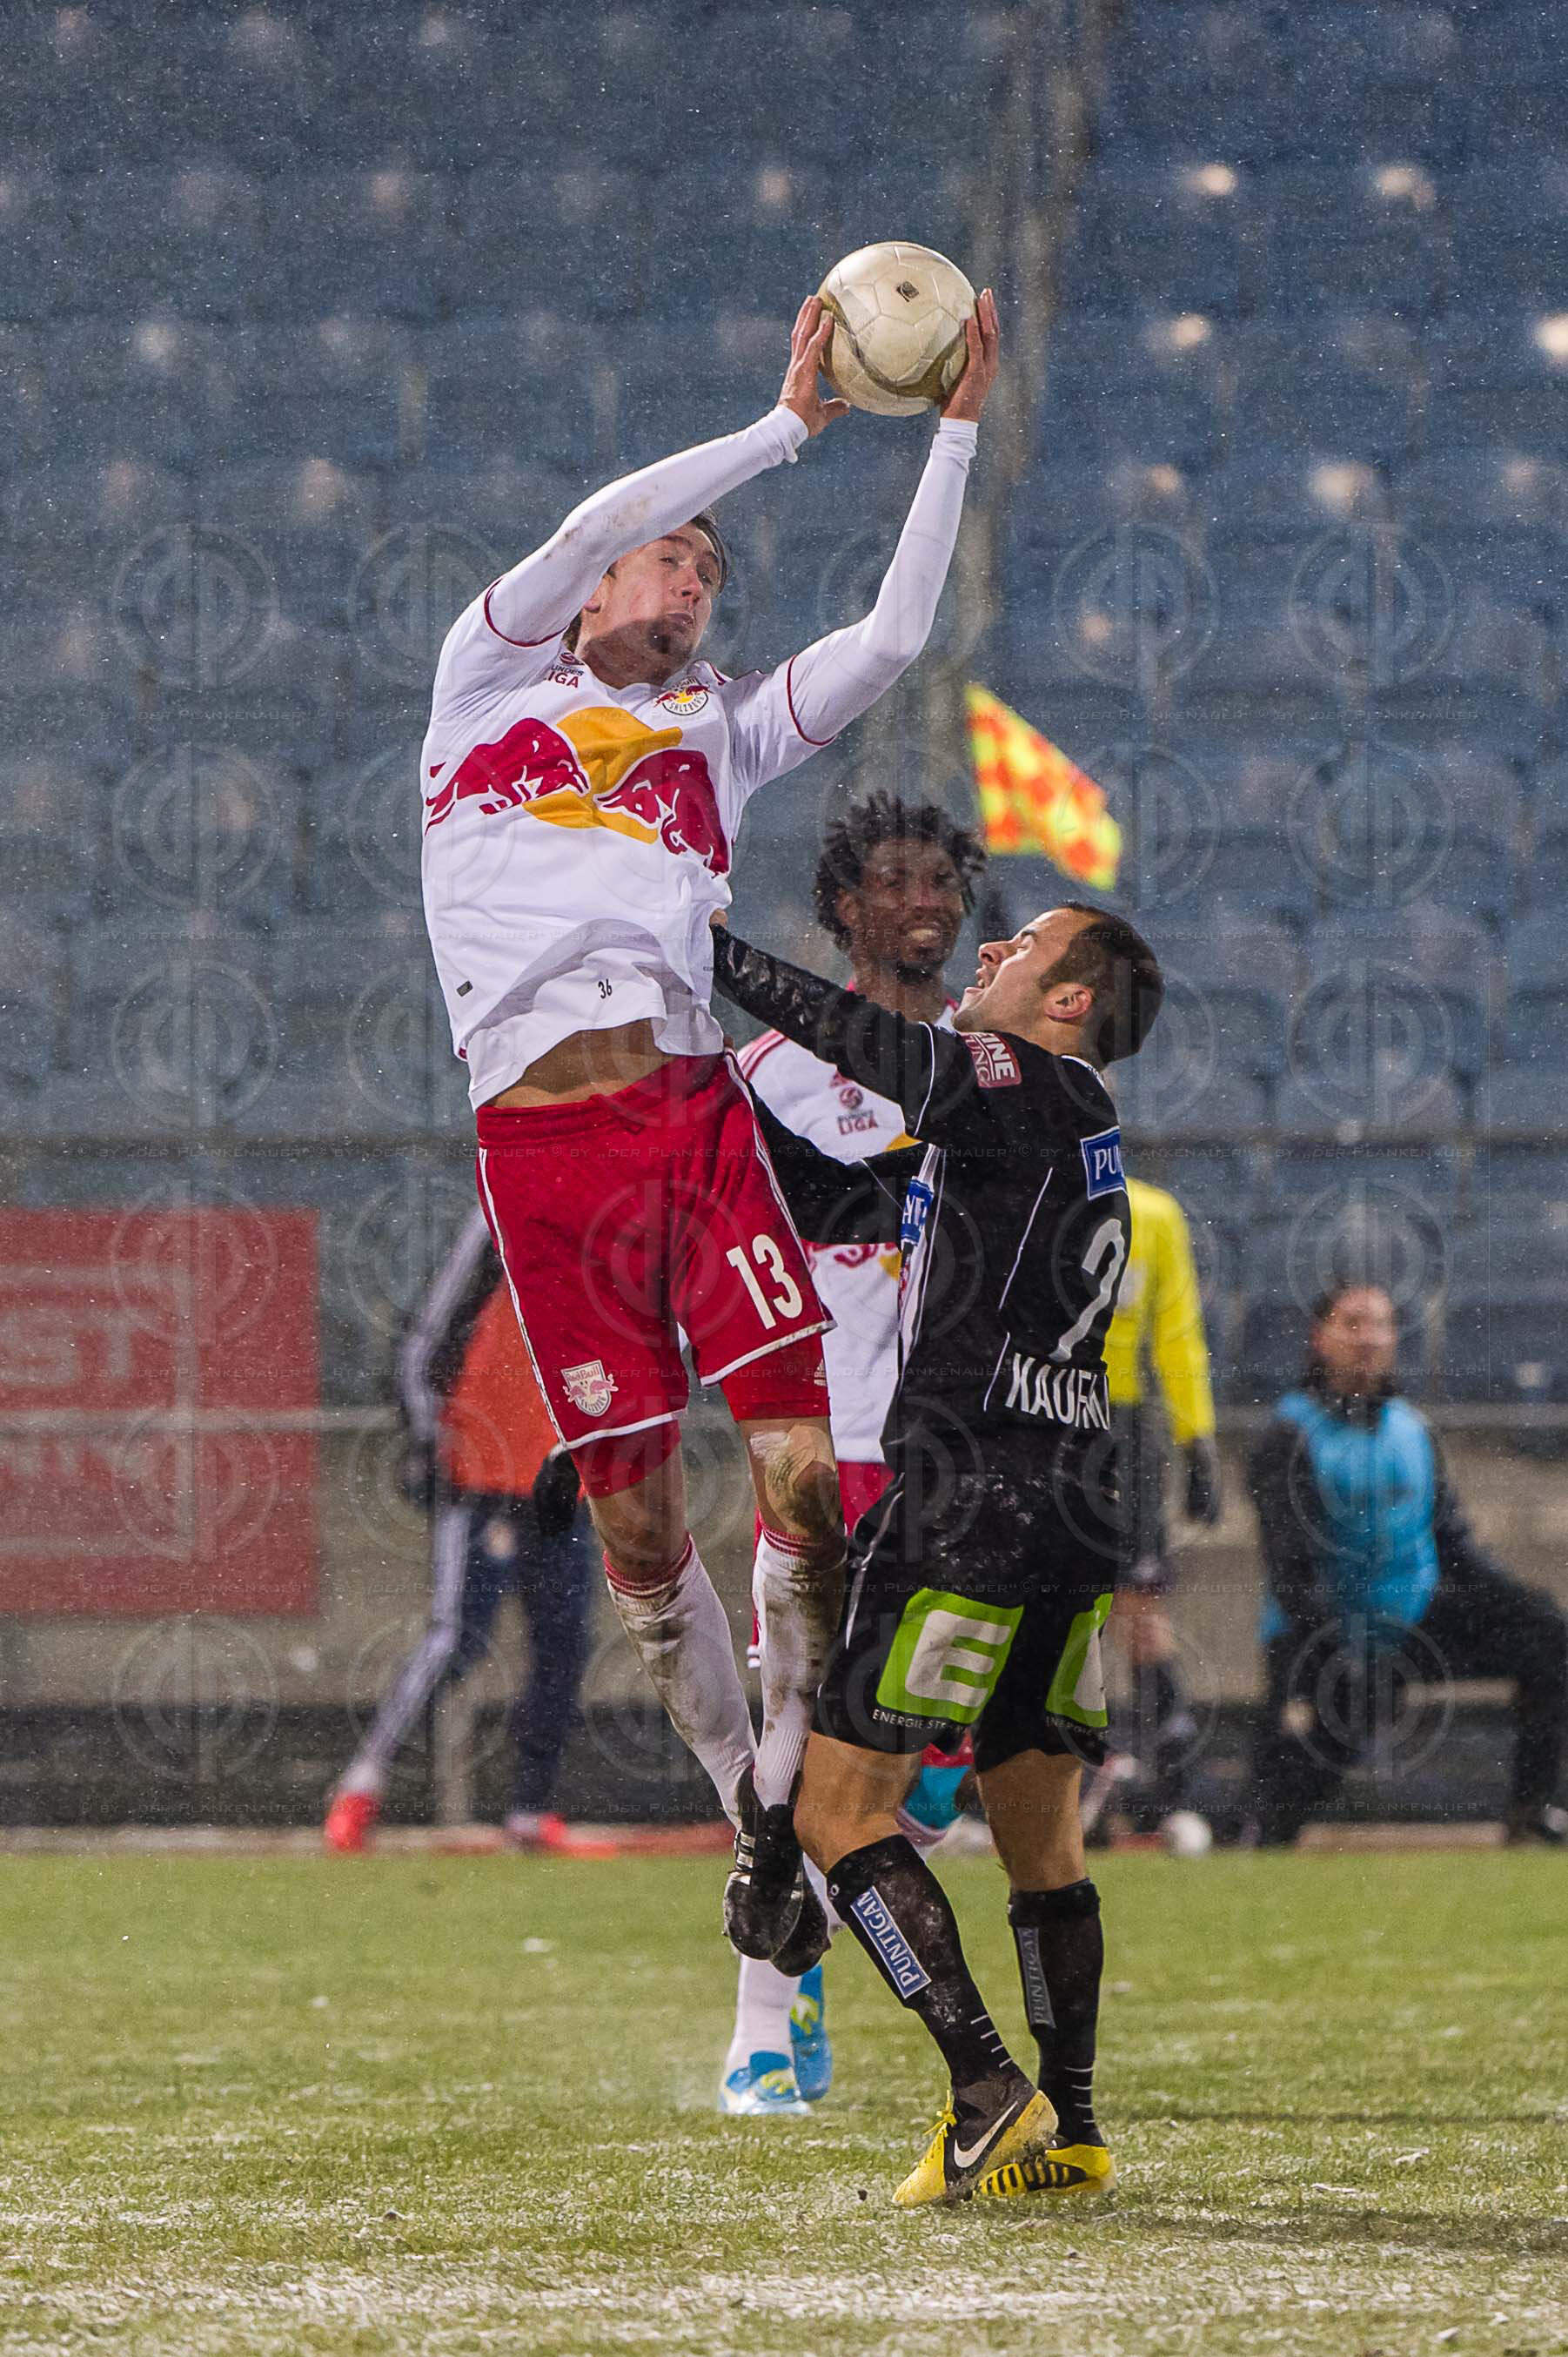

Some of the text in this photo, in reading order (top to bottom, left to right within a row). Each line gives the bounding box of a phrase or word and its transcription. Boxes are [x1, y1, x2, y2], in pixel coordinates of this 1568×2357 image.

[543, 670, 579, 688] IGA
[598, 978, 613, 999] 36
[726, 1233, 803, 1330] 13
[904, 1608, 1012, 1708] E
[872, 1708, 923, 1729] ENERGIE
